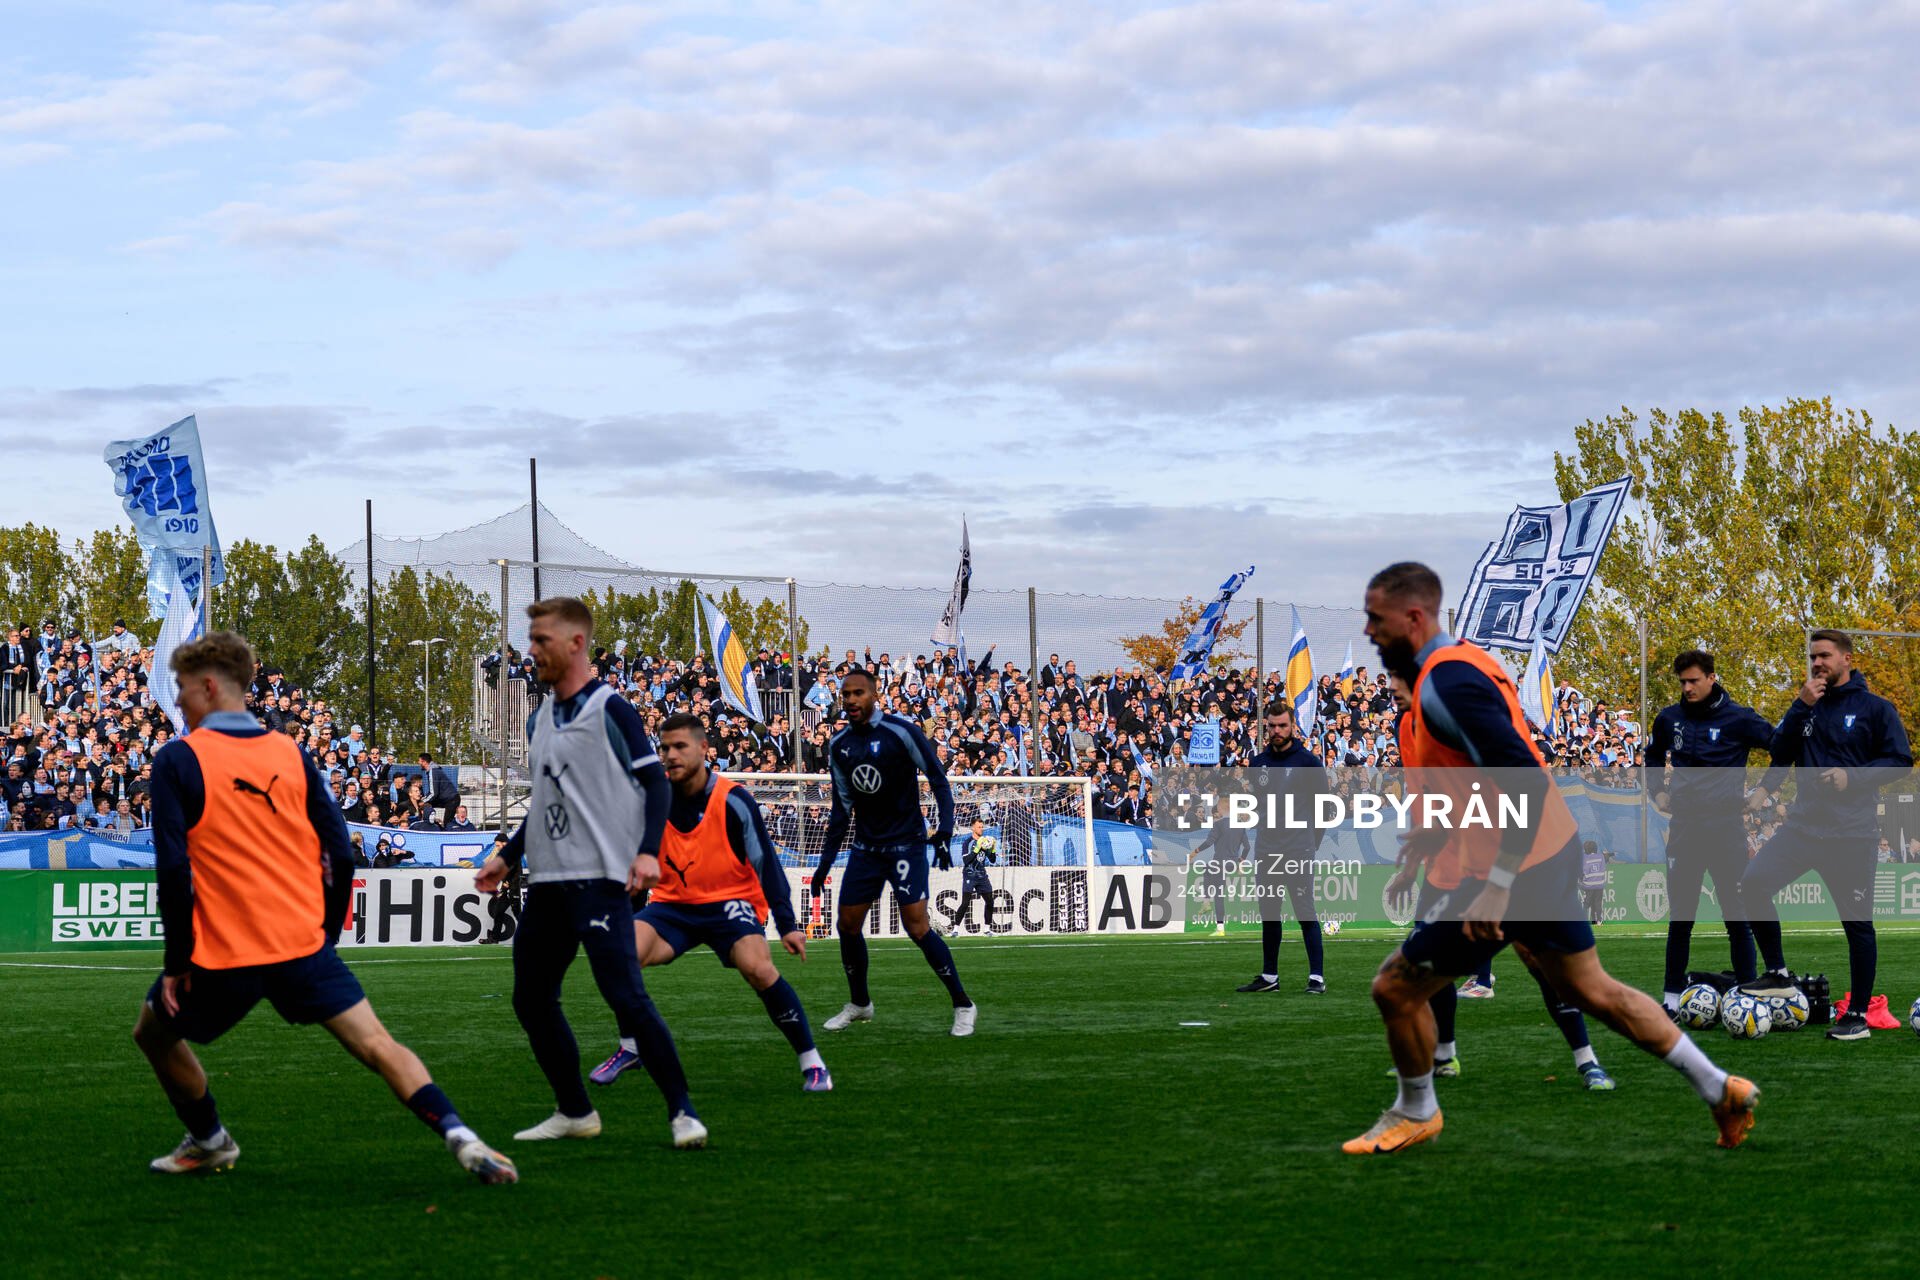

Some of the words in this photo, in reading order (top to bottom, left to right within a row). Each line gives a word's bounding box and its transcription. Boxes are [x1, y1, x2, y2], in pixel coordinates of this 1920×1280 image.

[165, 517, 200, 534] 1910
[896, 859, 910, 881] 9
[1097, 874, 1173, 931] AB
[1689, 1002, 1715, 1017] SELECT
